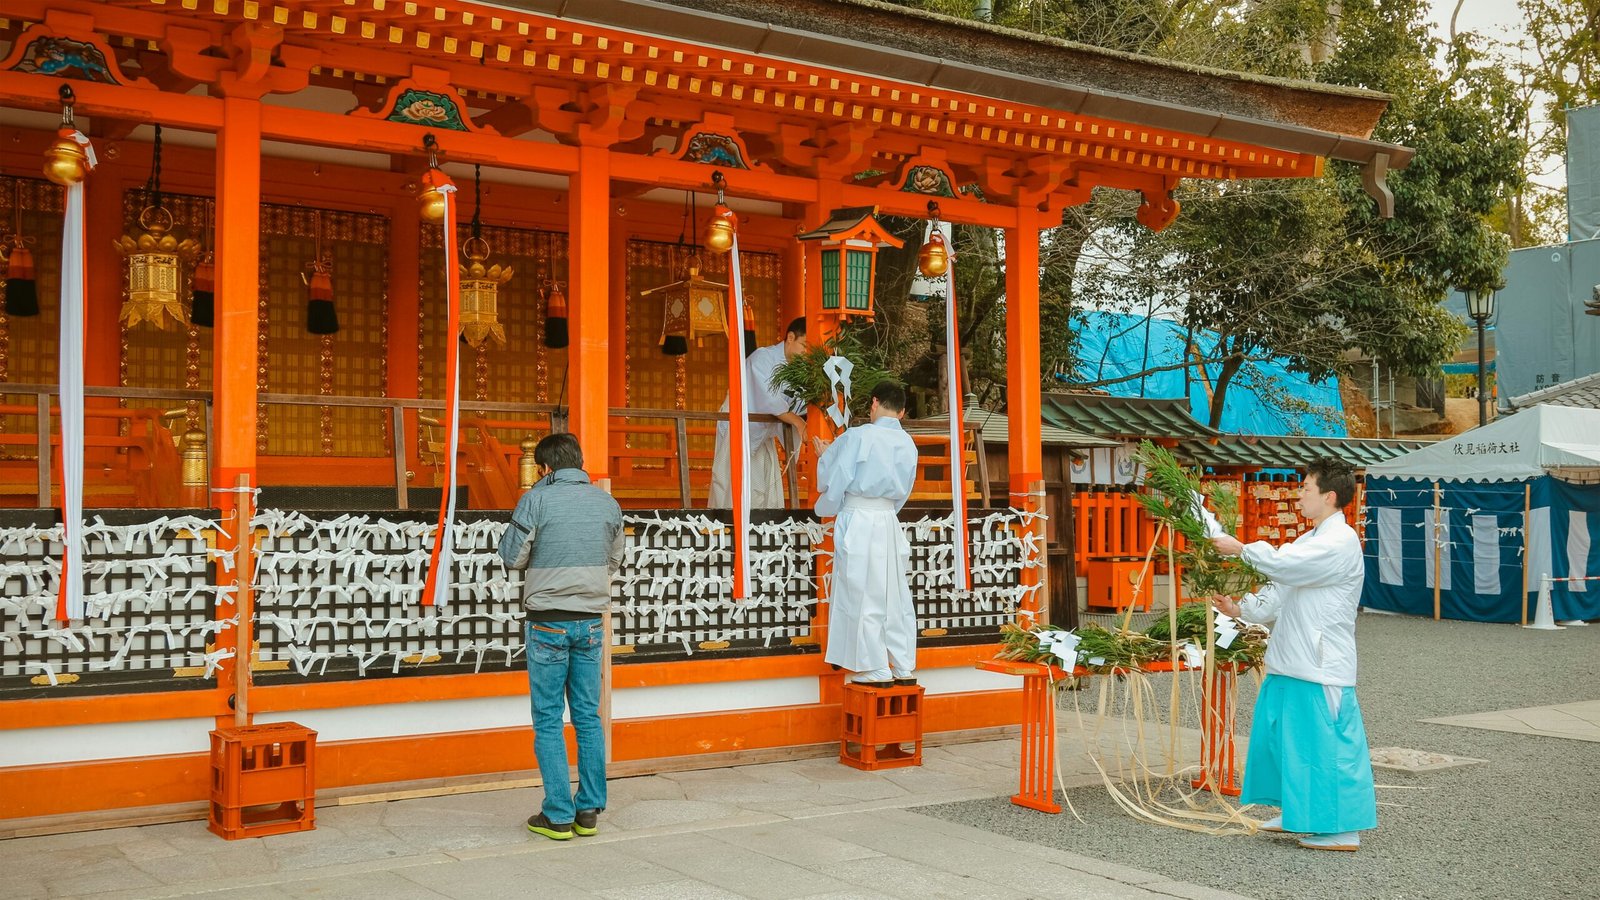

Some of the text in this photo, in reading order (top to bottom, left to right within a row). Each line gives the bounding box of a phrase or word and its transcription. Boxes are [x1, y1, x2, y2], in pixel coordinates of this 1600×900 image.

[1453, 441, 1520, 455] 伏見稲荷大社
